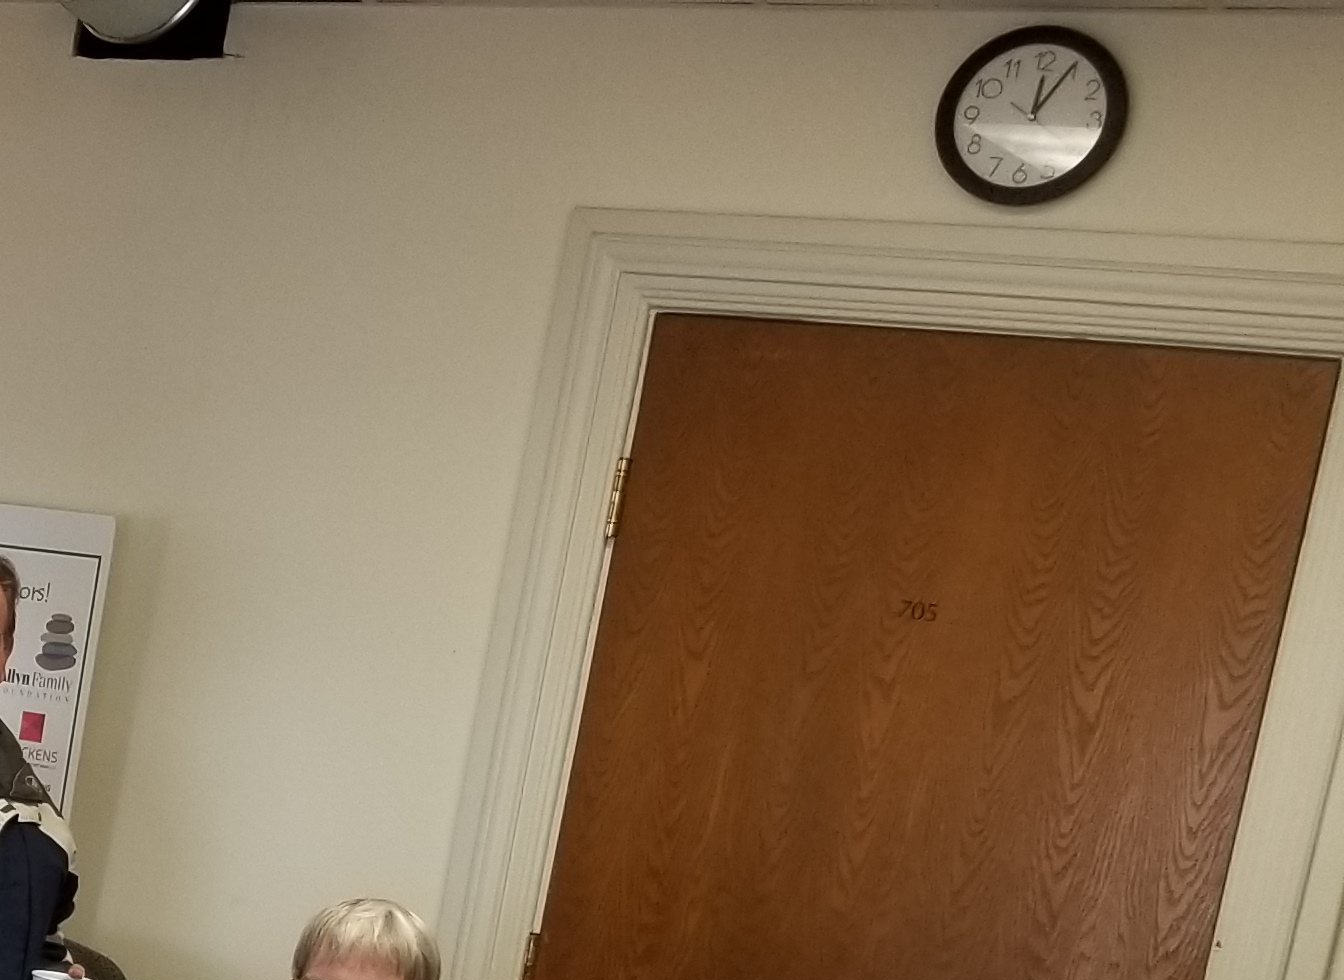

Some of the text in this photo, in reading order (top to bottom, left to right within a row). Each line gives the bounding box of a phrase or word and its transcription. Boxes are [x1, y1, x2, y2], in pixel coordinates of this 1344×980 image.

[1004, 59, 1021, 79] 11
[1035, 51, 1057, 71] 12
[976, 78, 1003, 99] 10
[1085, 79, 1100, 101] 2
[964, 105, 980, 125] 9
[967, 134, 982, 155] 8
[990, 156, 1003, 177] 7
[1013, 163, 1027, 184] 6
[898, 600, 938, 621] 705
[32, 671, 72, 693] Family
[3, 688, 69, 702] OUNDATION
